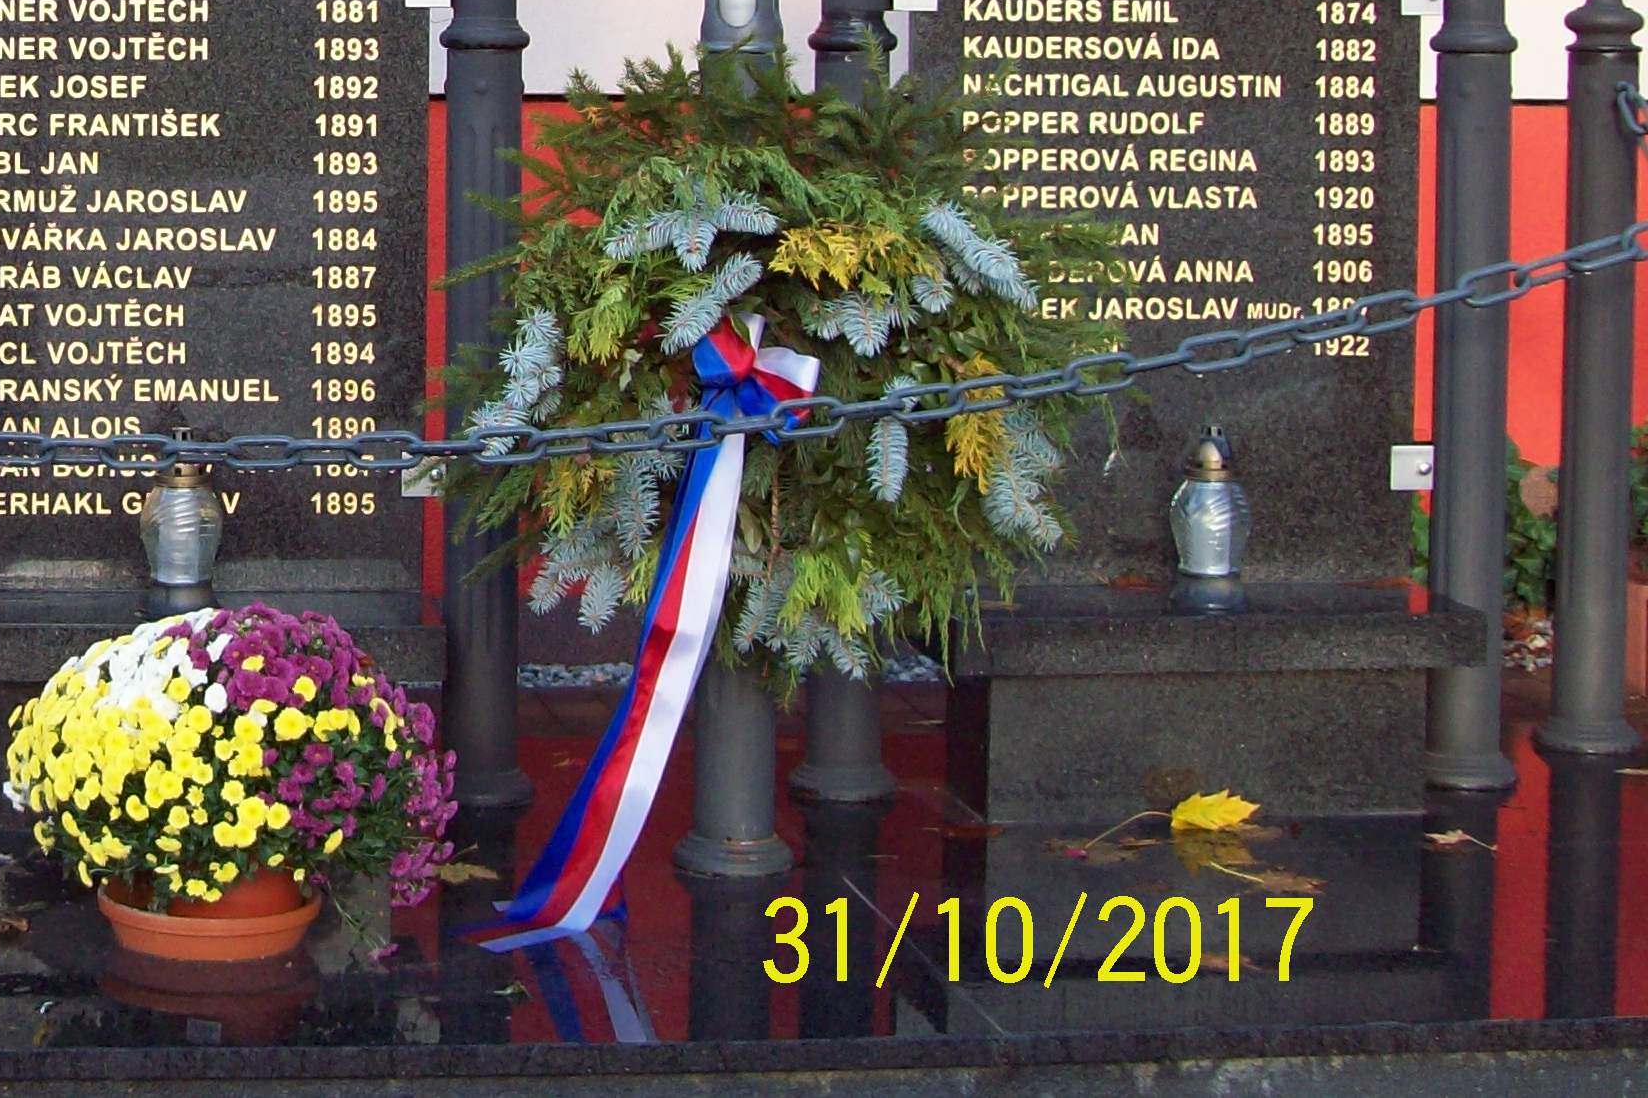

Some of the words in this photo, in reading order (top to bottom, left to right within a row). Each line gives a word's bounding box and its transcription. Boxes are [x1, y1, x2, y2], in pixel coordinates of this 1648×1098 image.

[315, 0, 378, 24] 1881
[1112, 0, 1179, 24] EMIL
[1316, 1, 1377, 25] 1874
[963, 31, 1163, 60] KAUDERSOVÁ
[1172, 37, 1220, 60] IDA
[1315, 38, 1376, 62] 1882
[49, 74, 147, 99] JOSEF
[313, 75, 378, 100] 1892
[49, 108, 221, 138] FRANTIŠEK
[315, 113, 377, 137] 1891
[40, 151, 99, 175] JAN
[313, 151, 378, 176] 1893
[86, 189, 247, 214] JAROSLAV
[312, 189, 378, 214] 1895
[115, 227, 277, 252] JAROSLAV
[312, 227, 378, 252] 1884
[72, 260, 193, 290] VÁCLAV
[311, 265, 377, 290] 1887
[44, 298, 184, 327] VOJTĚCH
[311, 303, 377, 327] 1895
